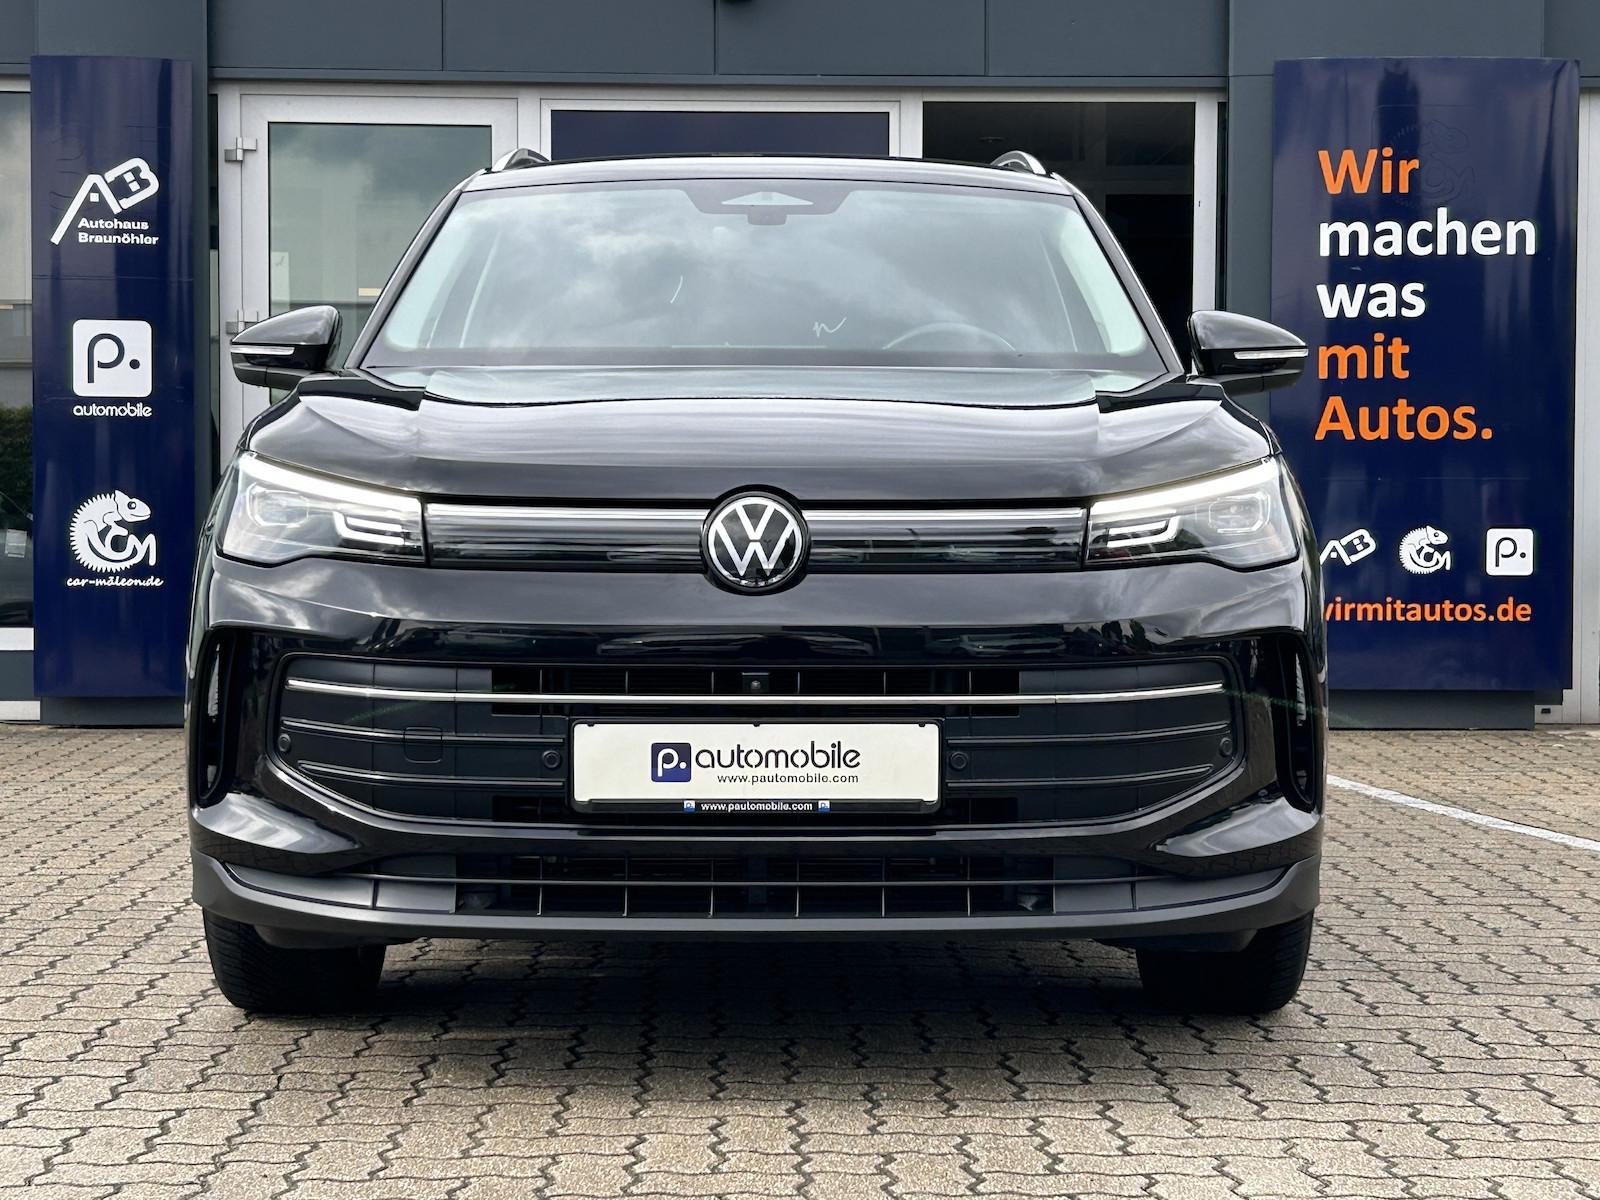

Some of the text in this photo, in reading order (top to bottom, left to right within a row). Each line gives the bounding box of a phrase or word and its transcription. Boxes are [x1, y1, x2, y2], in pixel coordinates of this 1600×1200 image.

[1318, 147, 1419, 194] Wir
[78, 217, 149, 230] Autohaus
[1319, 207, 1536, 256] machen
[78, 232, 159, 245] Braunöhler
[1316, 282, 1427, 319] was
[1318, 332, 1410, 380] mit
[73, 402, 152, 417] automobile
[1315, 395, 1493, 441] Autos.
[695, 740, 861, 769] automobile
[717, 773, 859, 785] www.pautomobile.com
[700, 801, 813, 813] www.pautomobile.com
